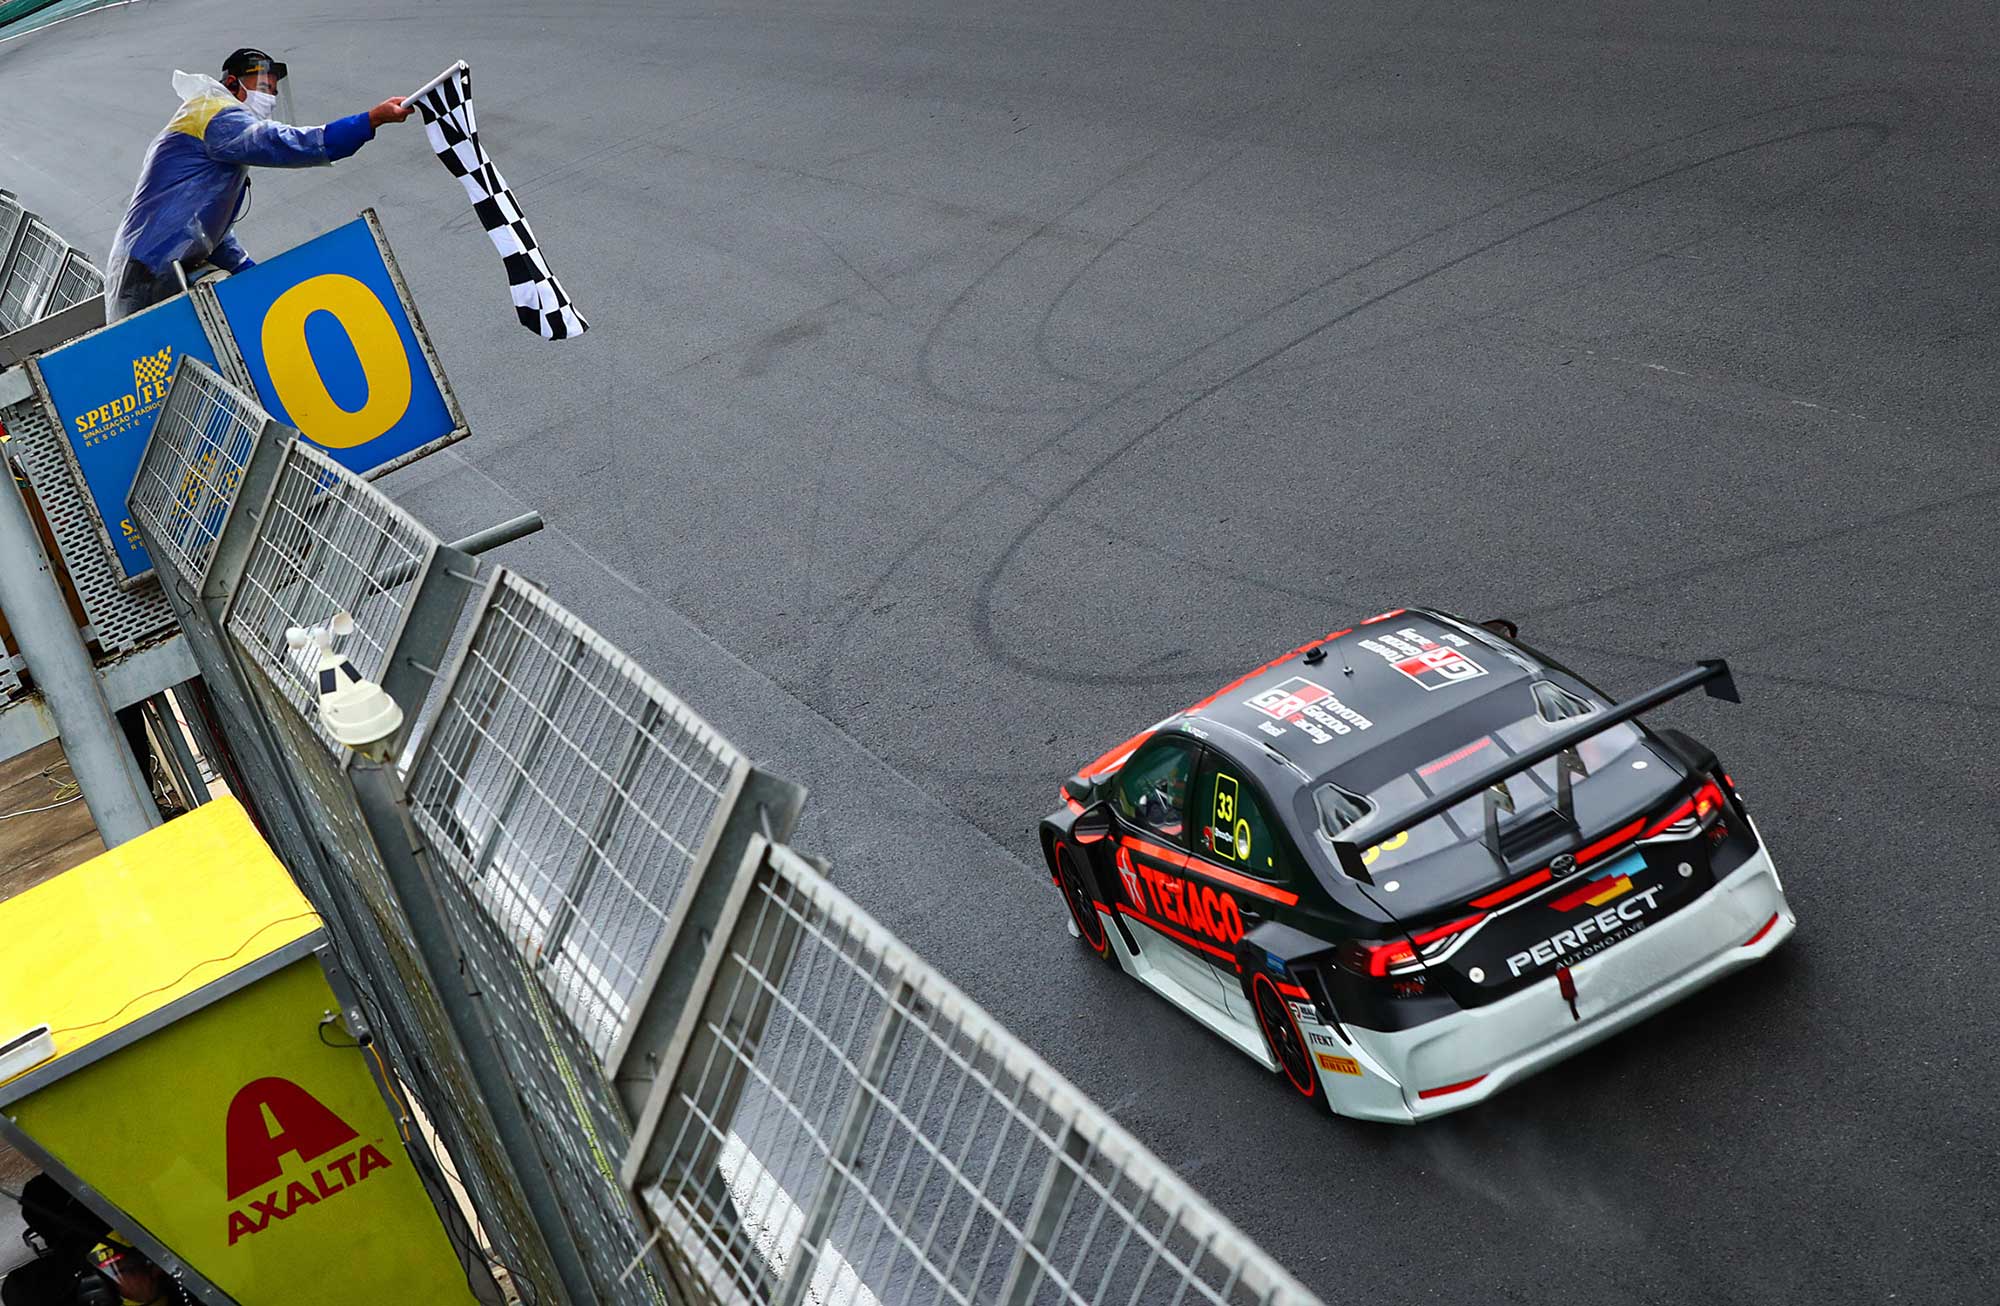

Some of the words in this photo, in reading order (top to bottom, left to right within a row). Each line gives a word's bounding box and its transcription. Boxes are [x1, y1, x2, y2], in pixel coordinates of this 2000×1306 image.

[261, 274, 411, 448] 0
[75, 394, 136, 432] SPEED
[83, 415, 130, 440] SINALIZAÇÃO
[86, 420, 140, 447] RESGATE
[1417, 647, 1479, 680] GR
[1251, 689, 1307, 719] GR
[1301, 705, 1351, 735] GAZOO
[1320, 696, 1373, 730] TOYOTA
[1286, 712, 1333, 744] Racing
[1217, 792, 1233, 822] 33
[1137, 863, 1245, 945] TEXACO
[1505, 885, 1660, 977] PERFECT
[1555, 921, 1646, 970] AUTOMOTIVE
[229, 1144, 392, 1246] AXALTA
